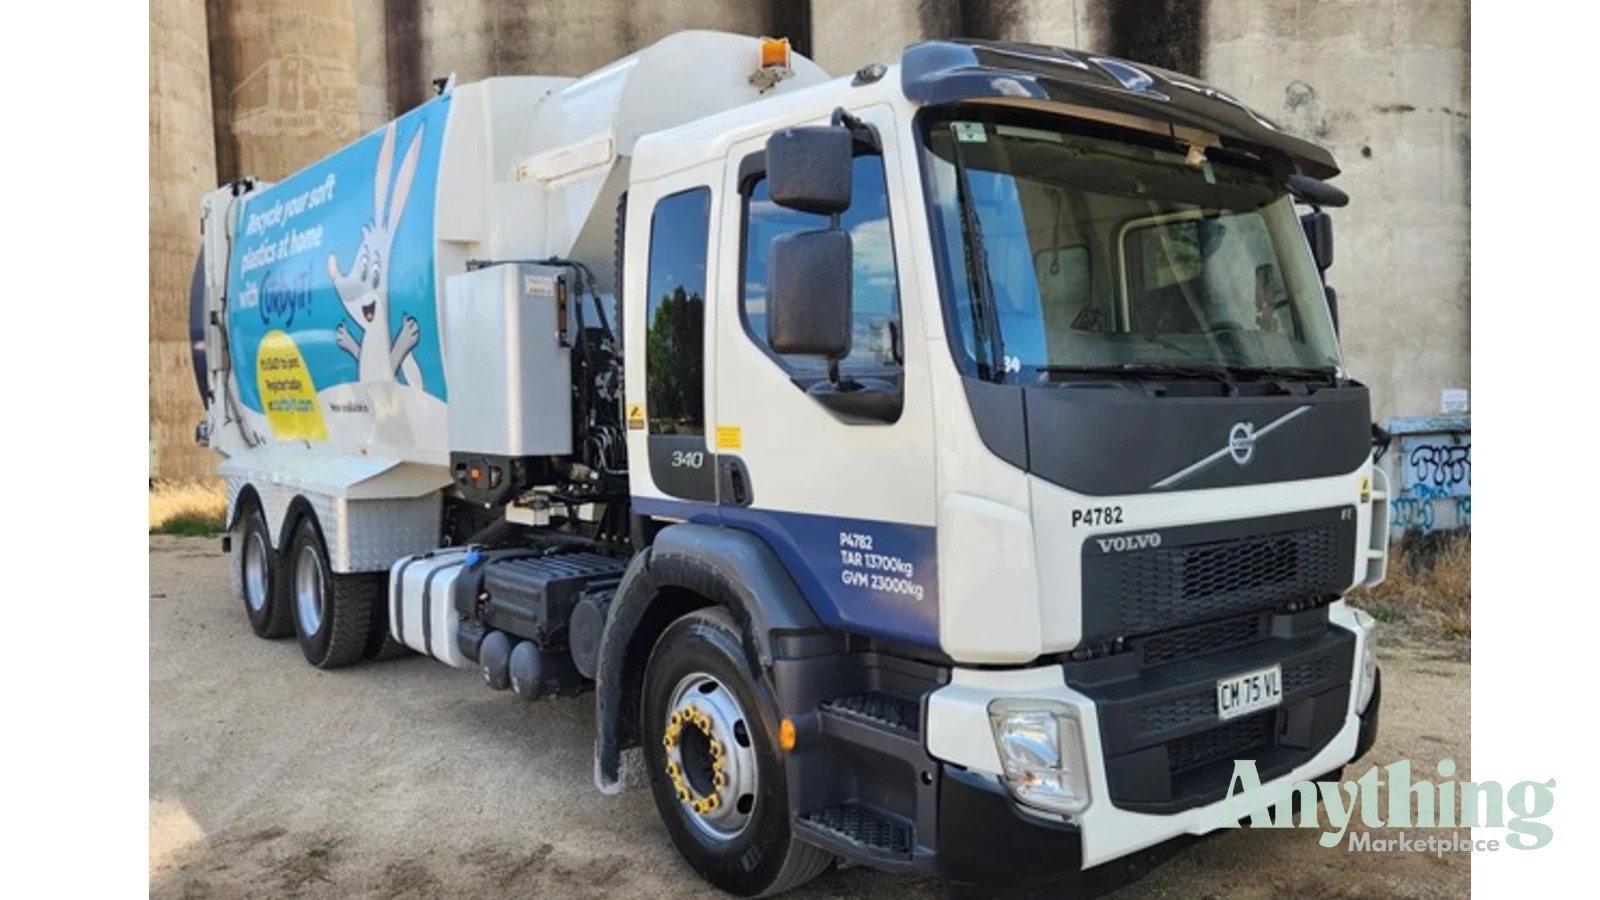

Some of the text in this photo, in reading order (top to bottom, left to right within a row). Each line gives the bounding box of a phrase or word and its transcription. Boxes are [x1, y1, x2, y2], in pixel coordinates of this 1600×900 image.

[246, 173, 336, 237] Recycle your soft
[240, 224, 323, 279] plastics at home
[239, 281, 259, 309] with
[671, 450, 704, 468] 340
[1071, 505, 1124, 527] P4782
[839, 532, 873, 550] P4782
[1096, 532, 1162, 553] VOLVO
[840, 549, 914, 578] TAR 13700kg
[841, 569, 925, 601] GVM 23000kg
[1221, 671, 1280, 711] CM 75 VL
